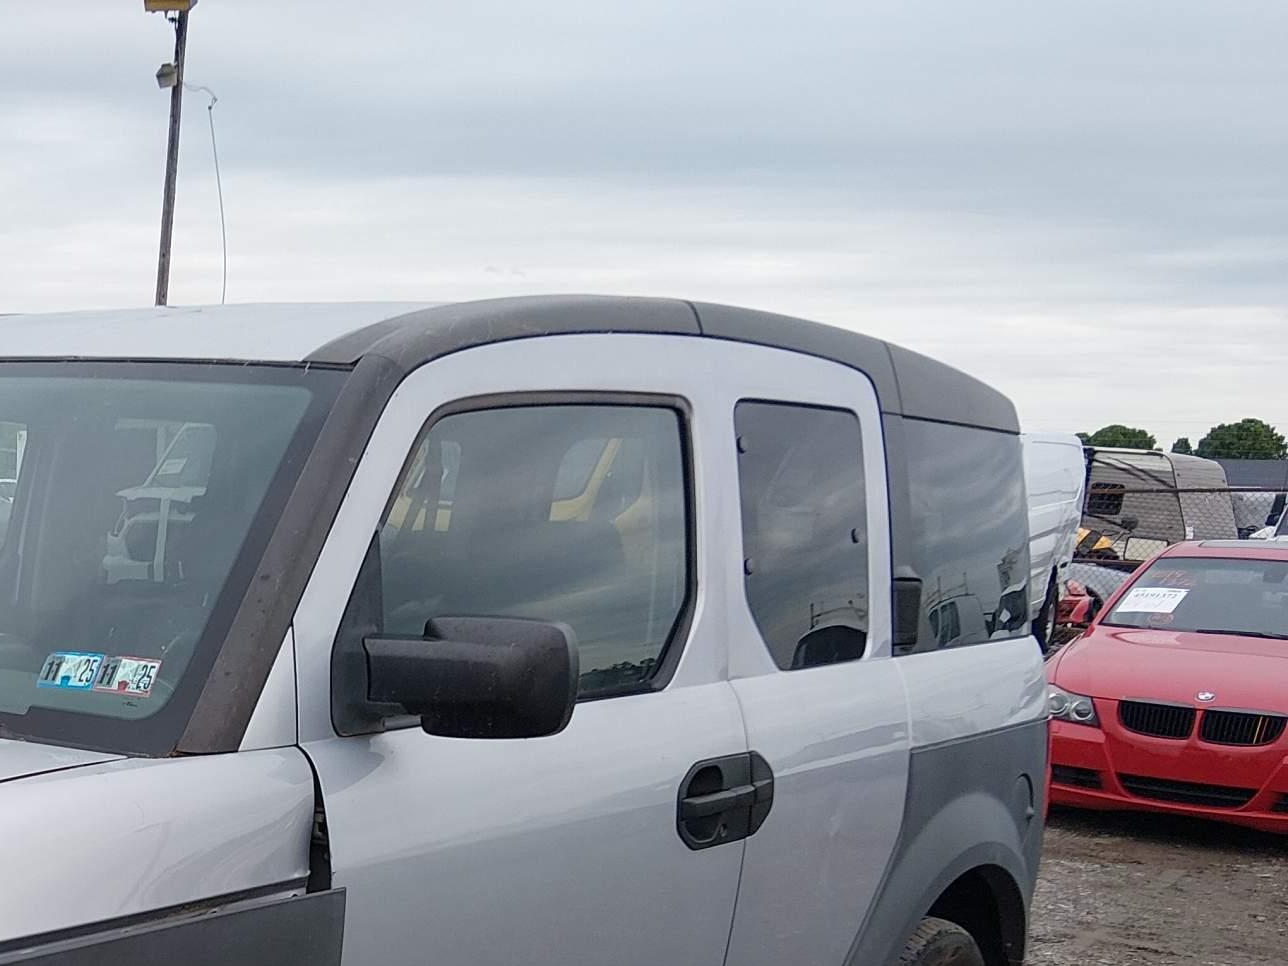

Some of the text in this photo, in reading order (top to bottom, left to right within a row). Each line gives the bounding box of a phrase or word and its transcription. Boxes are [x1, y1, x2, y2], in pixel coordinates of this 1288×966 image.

[43, 658, 99, 683] 11 25
[99, 663, 156, 690] 11 25
